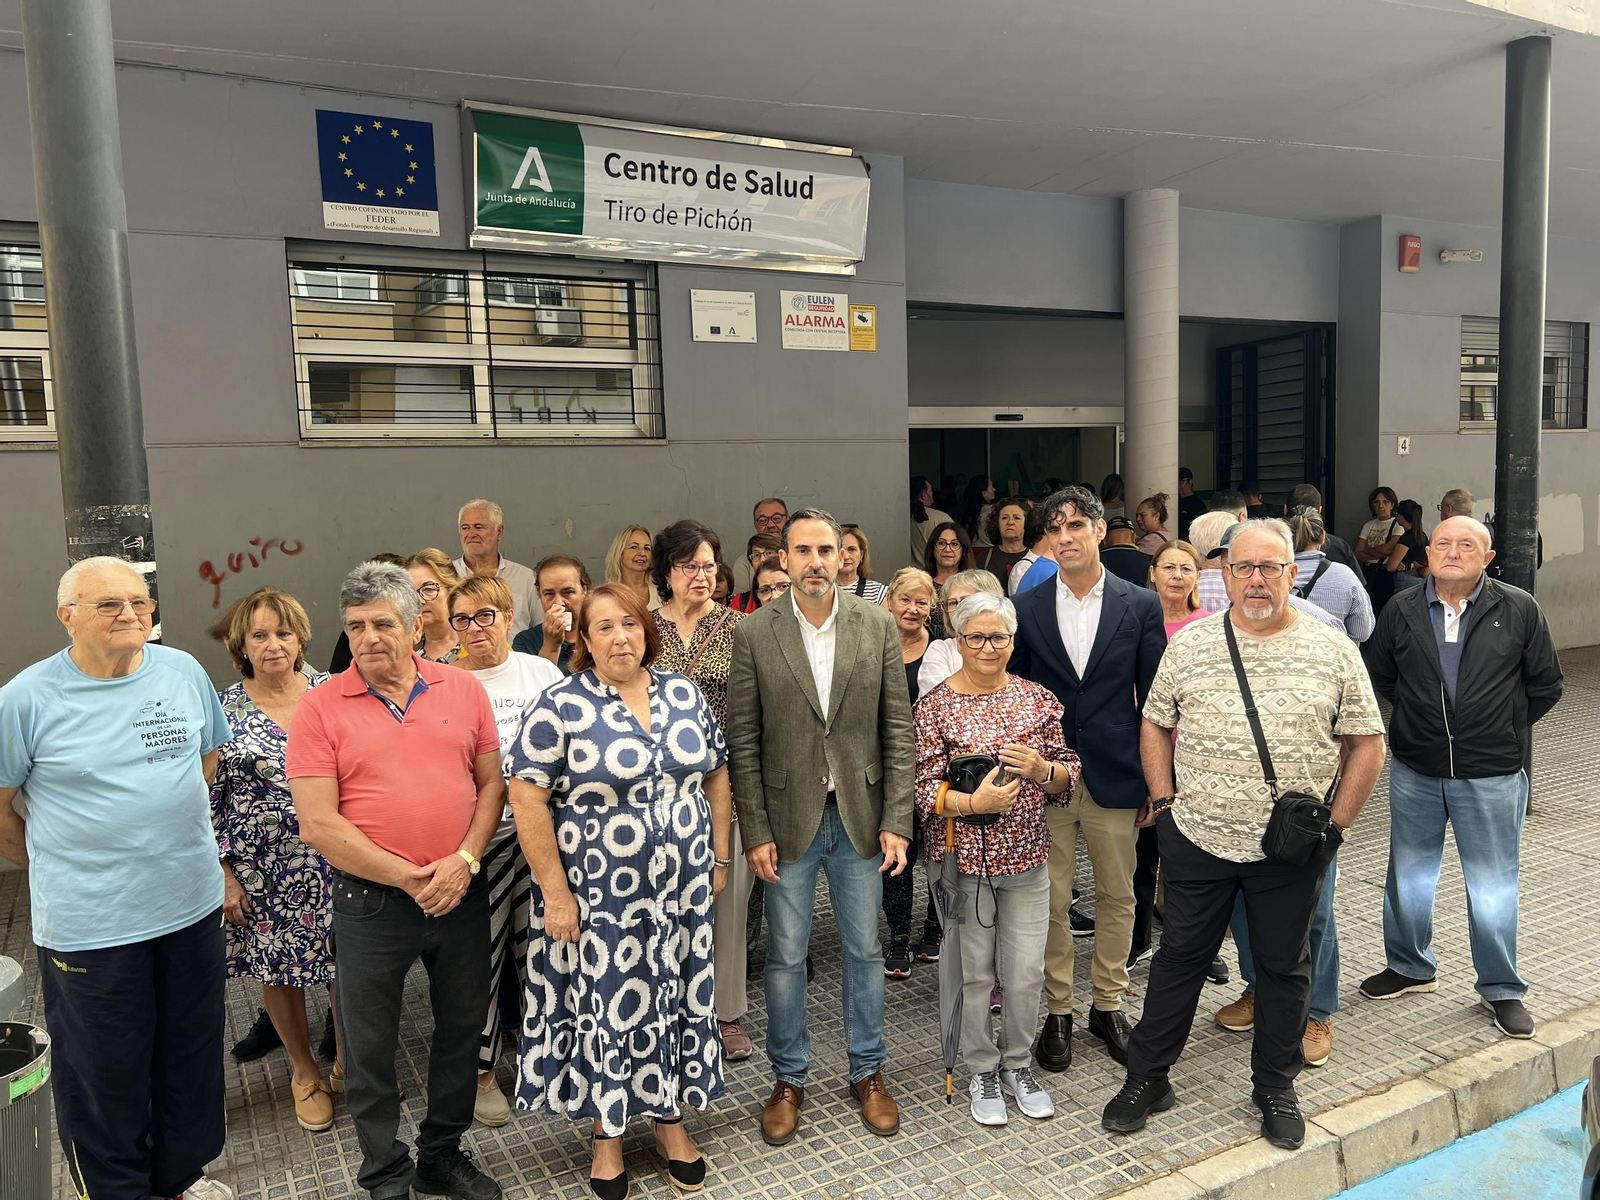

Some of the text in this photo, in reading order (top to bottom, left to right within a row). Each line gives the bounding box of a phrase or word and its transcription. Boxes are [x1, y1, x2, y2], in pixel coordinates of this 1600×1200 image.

[604, 152, 814, 200] Centro de Salud
[484, 192, 576, 209] Junta de Andalucía
[330, 204, 358, 212] CENTRO
[358, 206, 407, 216] COFINANCIADO
[604, 199, 752, 232] Tiro de Pichón
[366, 214, 397, 224] FEDER
[351, 223, 374, 231] Europeo
[807, 295, 835, 305] EULEN
[784, 314, 846, 329] ALARMA
[1400, 439, 1407, 451] 4
[155, 710, 167, 718] DÍA
[132, 716, 188, 729] INTERNACIONAL
[140, 727, 187, 741] PERSONAS
[145, 735, 188, 749] MAYORES
